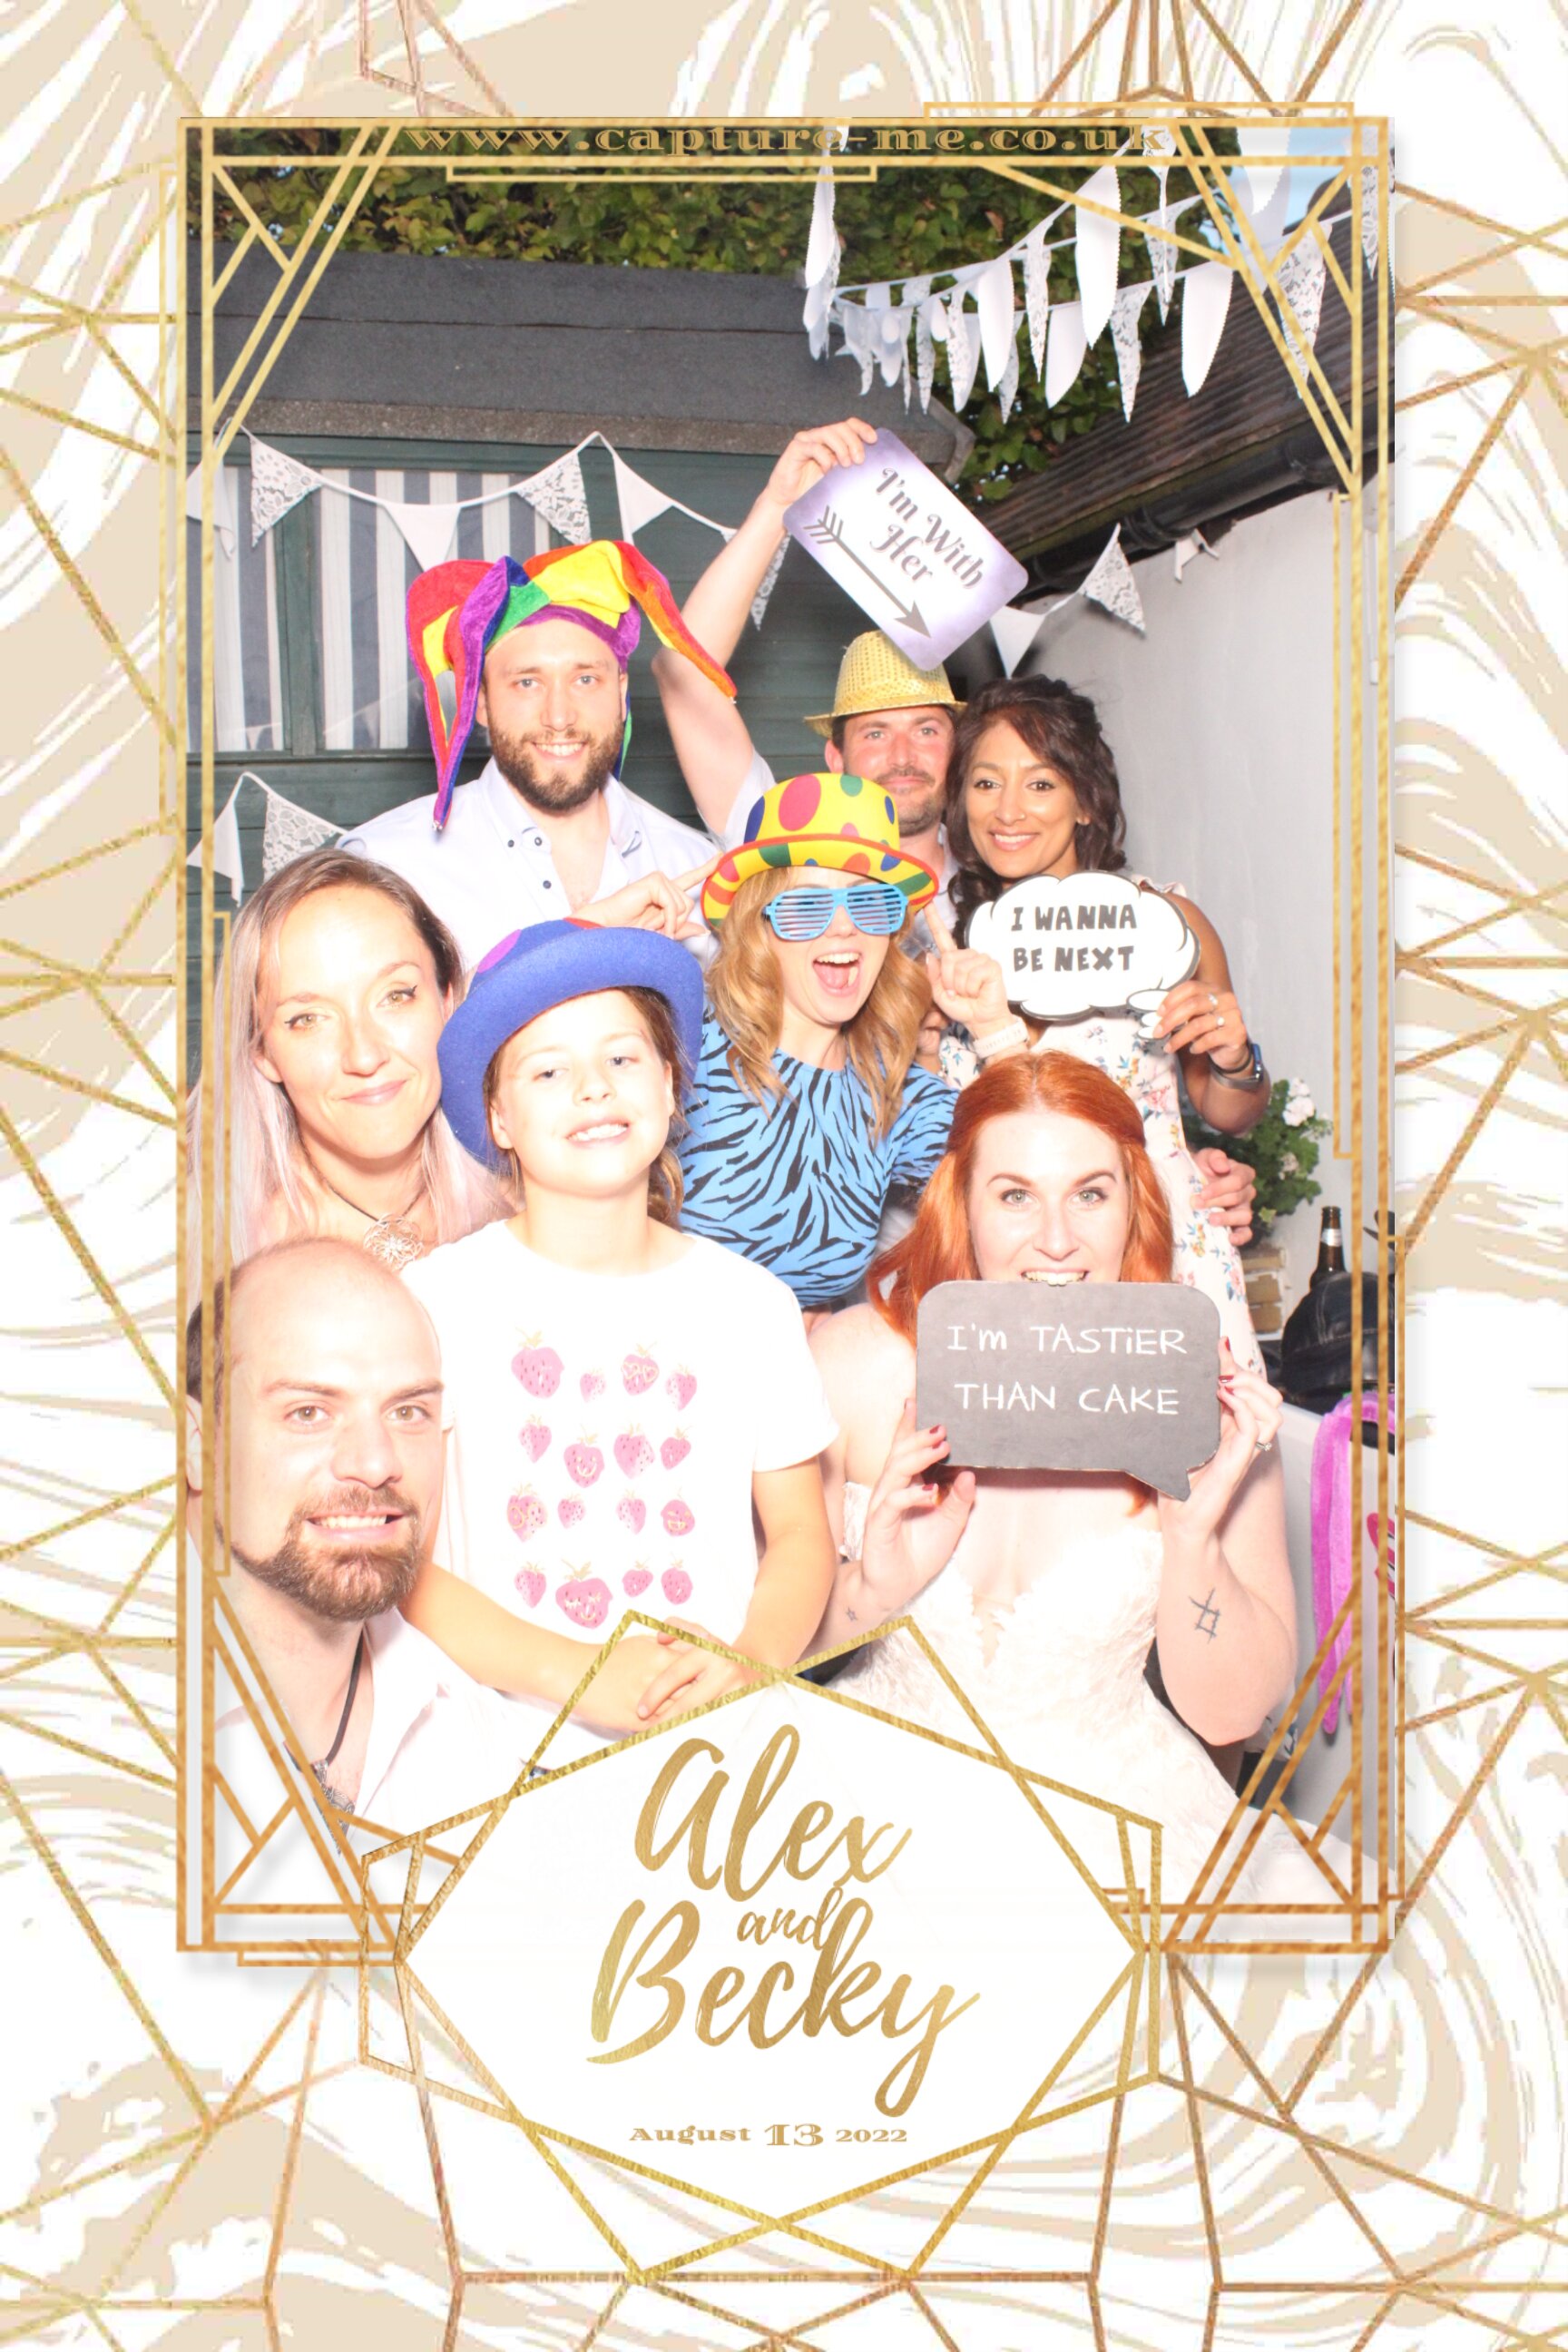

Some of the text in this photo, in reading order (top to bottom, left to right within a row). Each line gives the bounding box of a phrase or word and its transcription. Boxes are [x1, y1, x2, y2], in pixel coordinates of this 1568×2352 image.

[876, 468, 984, 588] I'm With
[869, 524, 934, 581] Her
[1010, 904, 1138, 931] I WANNA
[1013, 945, 1134, 972] BE NEXT
[946, 1323, 1007, 1351] I'm
[954, 1381, 1180, 1415] THAN CAKE
